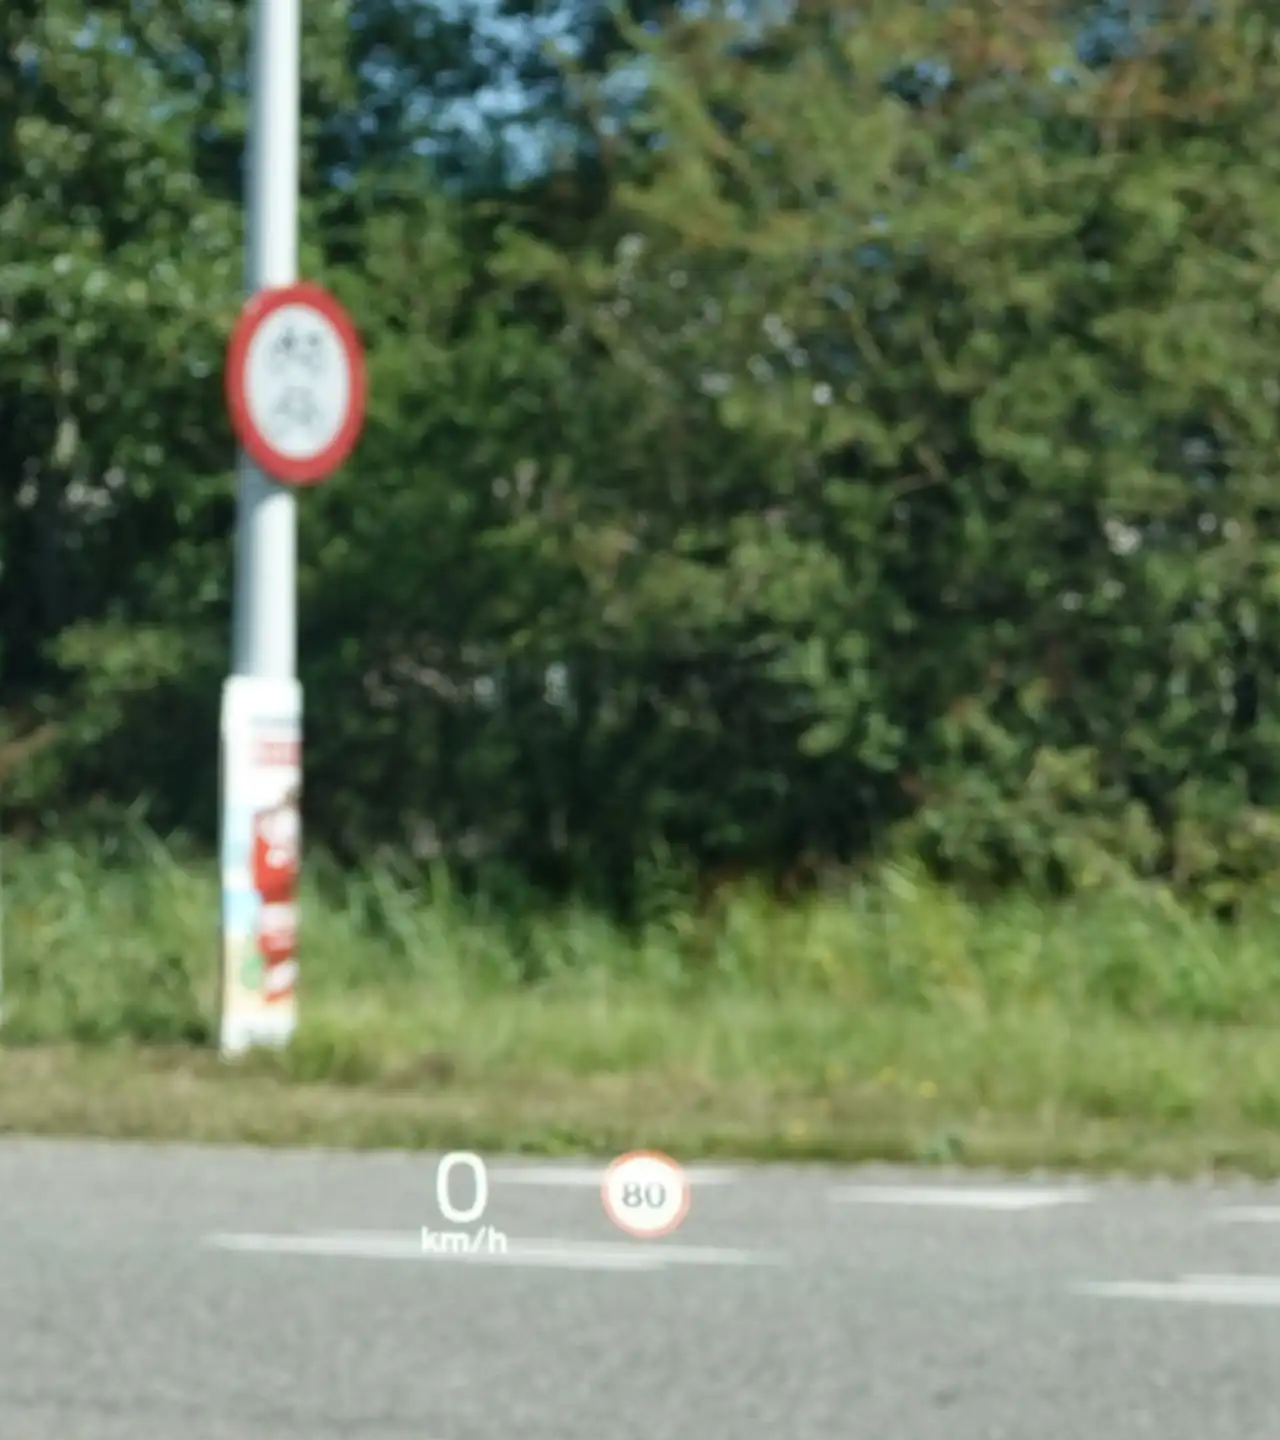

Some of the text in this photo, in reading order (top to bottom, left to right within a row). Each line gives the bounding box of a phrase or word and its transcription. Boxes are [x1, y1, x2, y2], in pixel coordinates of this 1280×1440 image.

[436, 1151, 488, 1223] 0
[621, 1182, 666, 1209] 80
[421, 1225, 508, 1253] km/h
